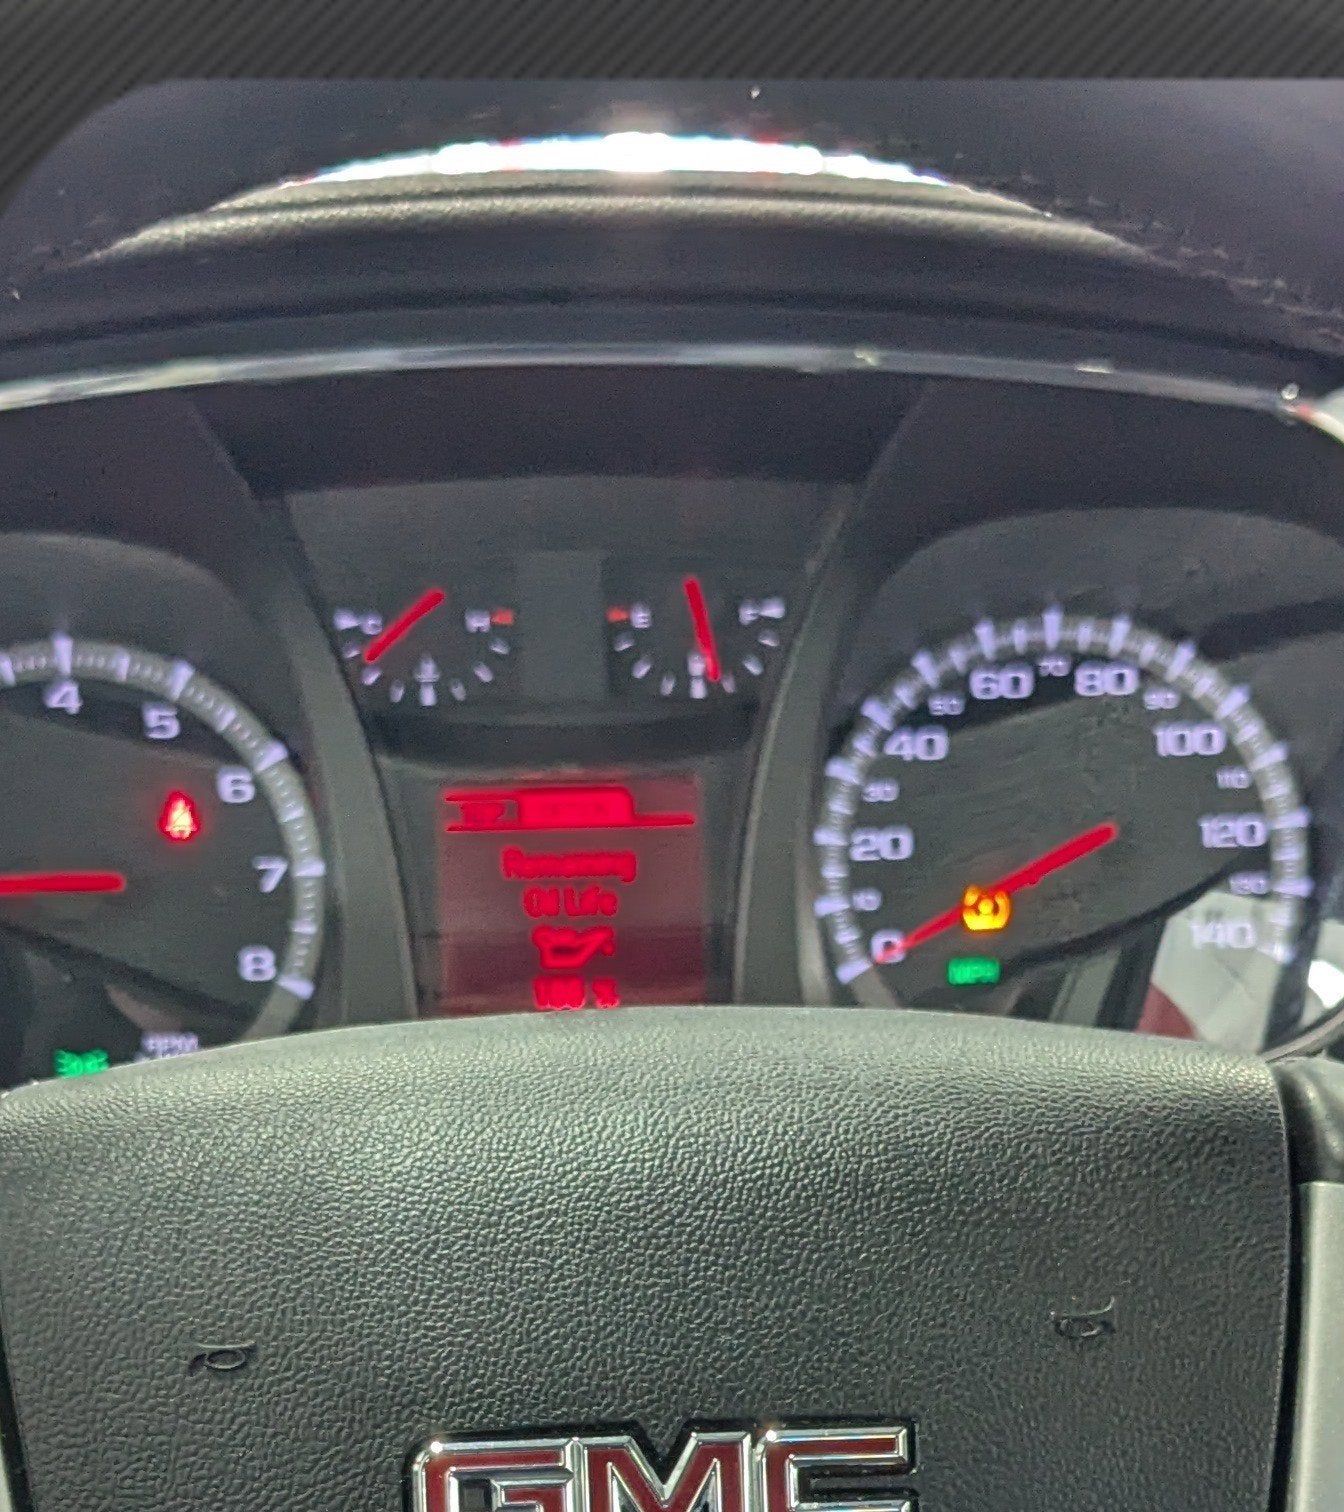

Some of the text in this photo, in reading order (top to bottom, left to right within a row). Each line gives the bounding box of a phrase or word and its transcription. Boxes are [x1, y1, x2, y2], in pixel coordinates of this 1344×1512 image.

[46, 680, 81, 714] 4
[969, 666, 1034, 700] 60
[1074, 663, 1139, 697] 80
[144, 704, 180, 740] 5
[884, 727, 948, 761] 40
[1154, 722, 1225, 757] 100
[217, 768, 255, 803] 6
[850, 827, 915, 862] 20
[1199, 815, 1269, 850] 120
[255, 859, 288, 893] 7
[1191, 919, 1254, 950] 140
[239, 948, 277, 983] 8
